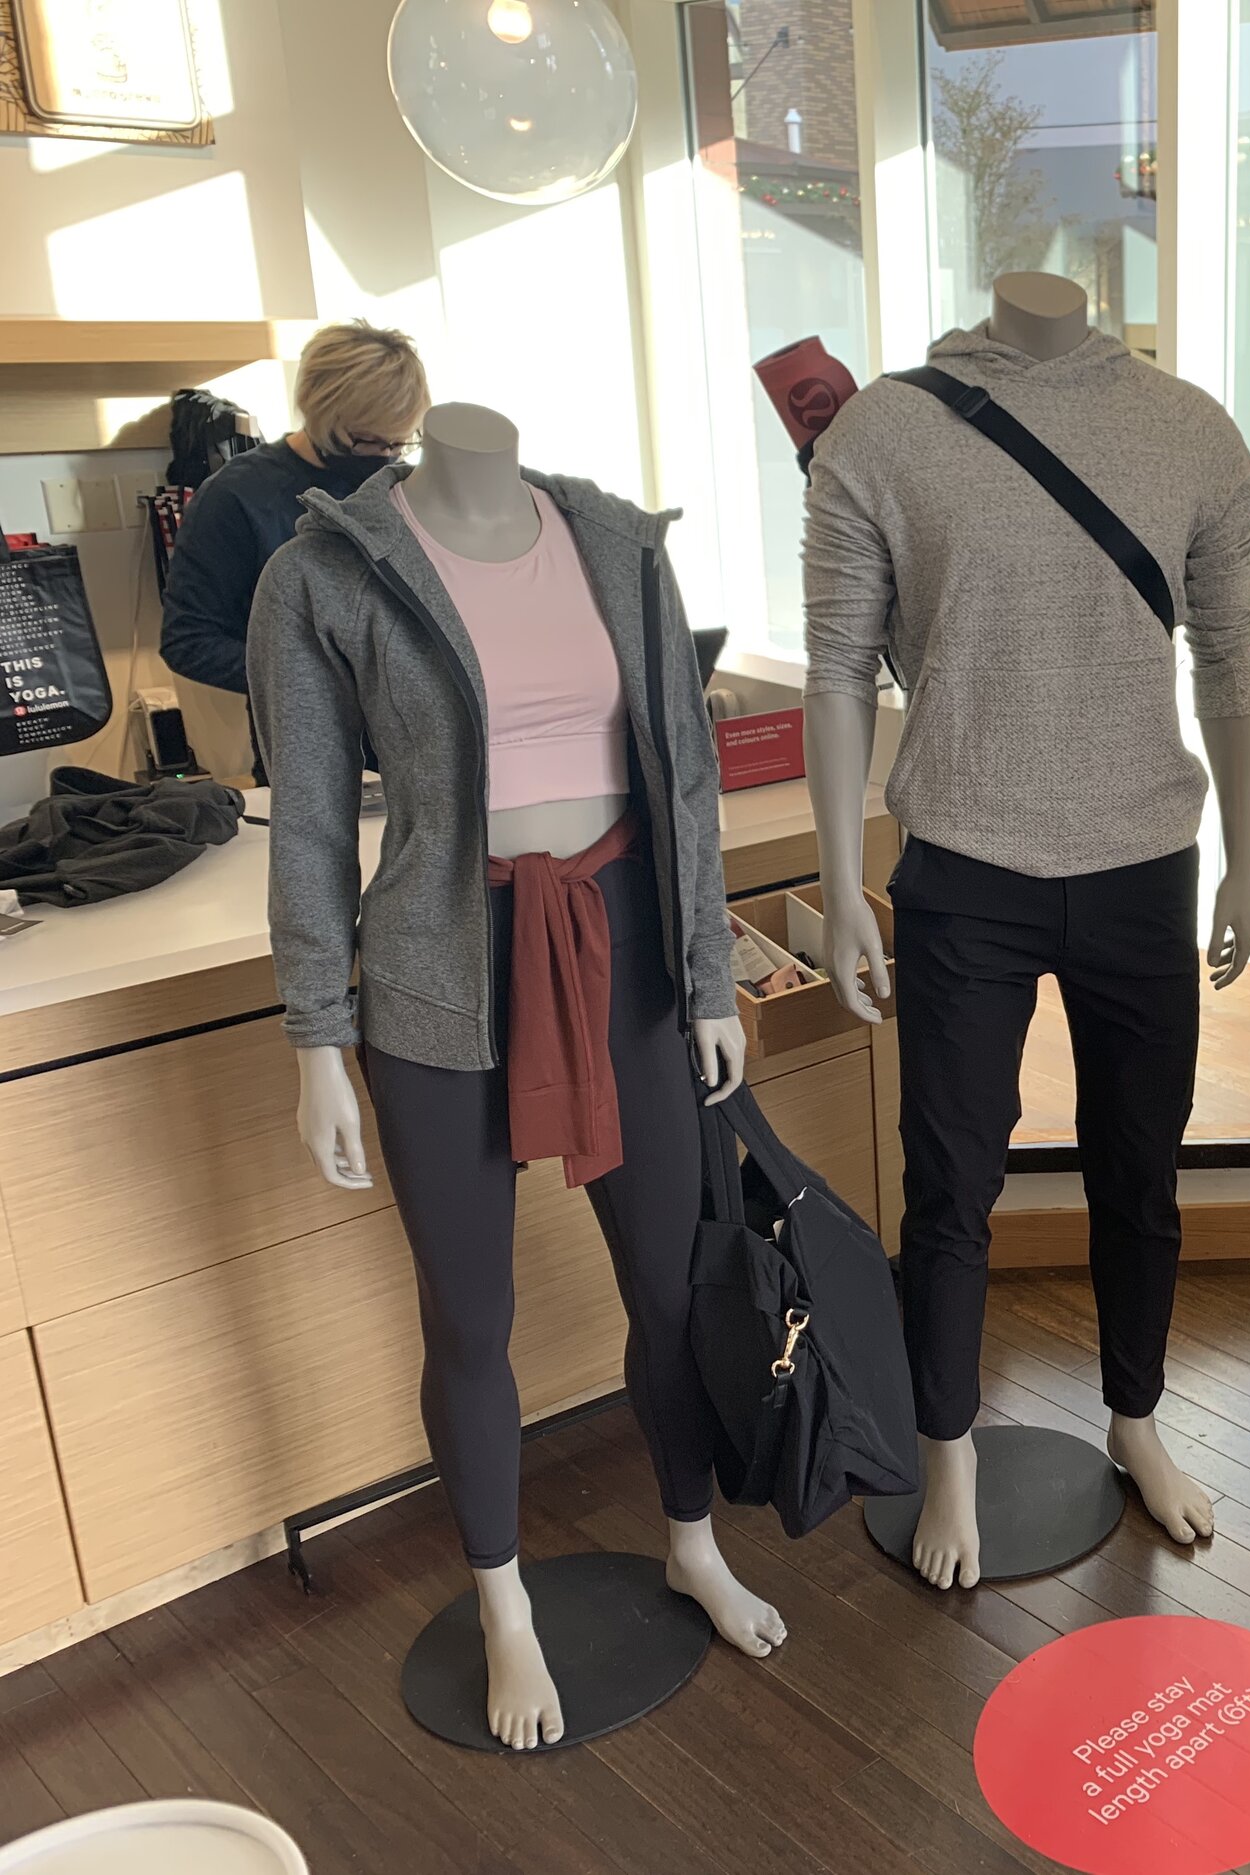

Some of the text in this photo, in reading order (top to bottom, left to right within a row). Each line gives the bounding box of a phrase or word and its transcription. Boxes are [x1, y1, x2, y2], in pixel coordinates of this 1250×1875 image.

[0, 657, 43, 673] THIS
[5, 675, 24, 689] IS
[9, 685, 65, 703] YOGA.
[27, 700, 69, 714] lululemon
[726, 739, 737, 747] and
[1072, 1676, 1195, 1765] Please stay
[1082, 1682, 1232, 1797] a full yoga mat
[1088, 1767, 1169, 1825] length
[1165, 1722, 1225, 1770] apart
